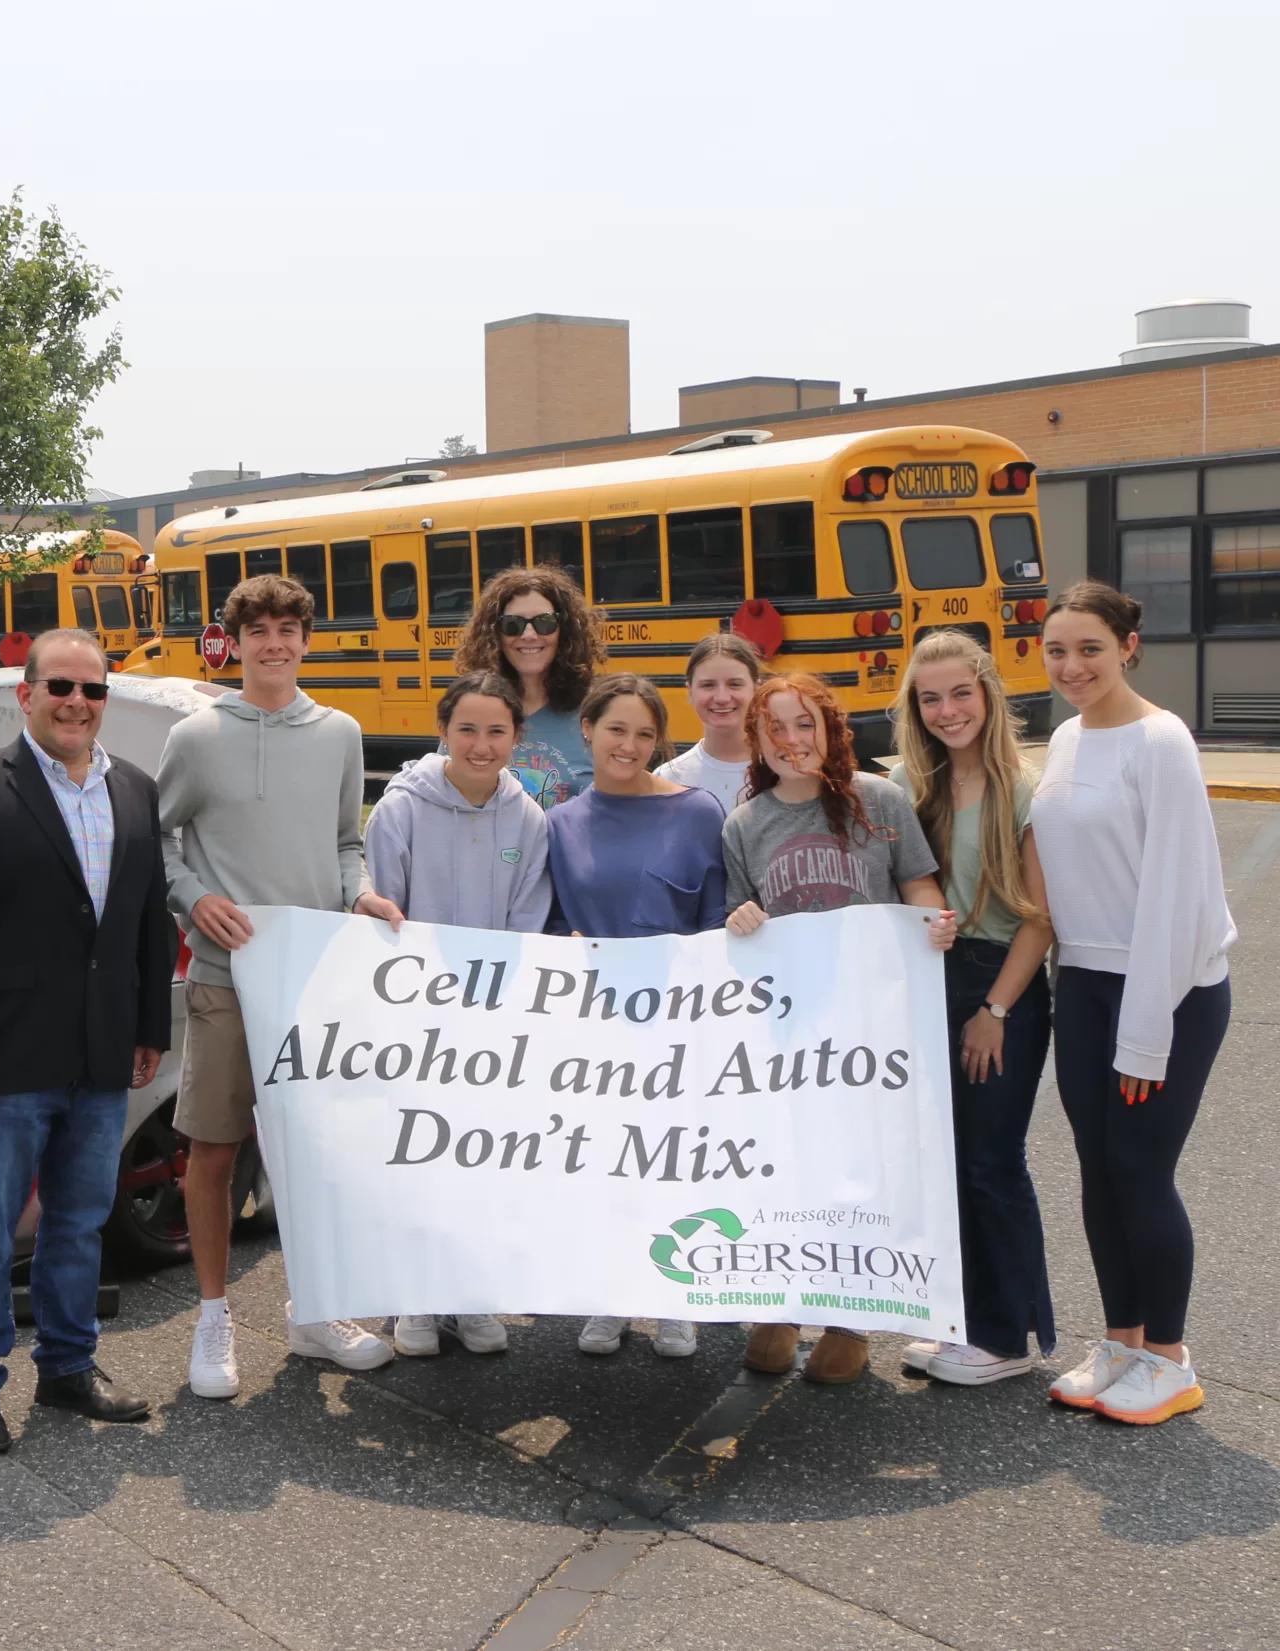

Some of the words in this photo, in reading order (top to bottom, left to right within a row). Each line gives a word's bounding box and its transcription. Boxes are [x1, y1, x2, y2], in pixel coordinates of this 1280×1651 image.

[897, 465, 949, 494] SCHOOL
[950, 465, 975, 492] BUS
[942, 597, 968, 616] 400
[115, 634, 124, 646] 399
[205, 638, 225, 655] STOP
[628, 623, 652, 641] INC.
[794, 847, 870, 902] CAROLIN
[372, 954, 505, 1013] Cell
[525, 965, 794, 1025] Phones,
[263, 1021, 528, 1090] Alcohol
[549, 1042, 687, 1101] and
[705, 1037, 912, 1096] Autos
[385, 1107, 592, 1176] Don't
[608, 1122, 777, 1183] Mix.
[752, 1208, 766, 1224] A
[773, 1208, 846, 1227] message
[847, 1205, 891, 1229] from
[686, 1241, 939, 1286] GERSHOW
[696, 1273, 930, 1300] RECYCLING
[686, 1291, 786, 1306] 855-GERSHOW
[799, 1291, 932, 1322] WWW.GERSHOW.COM
